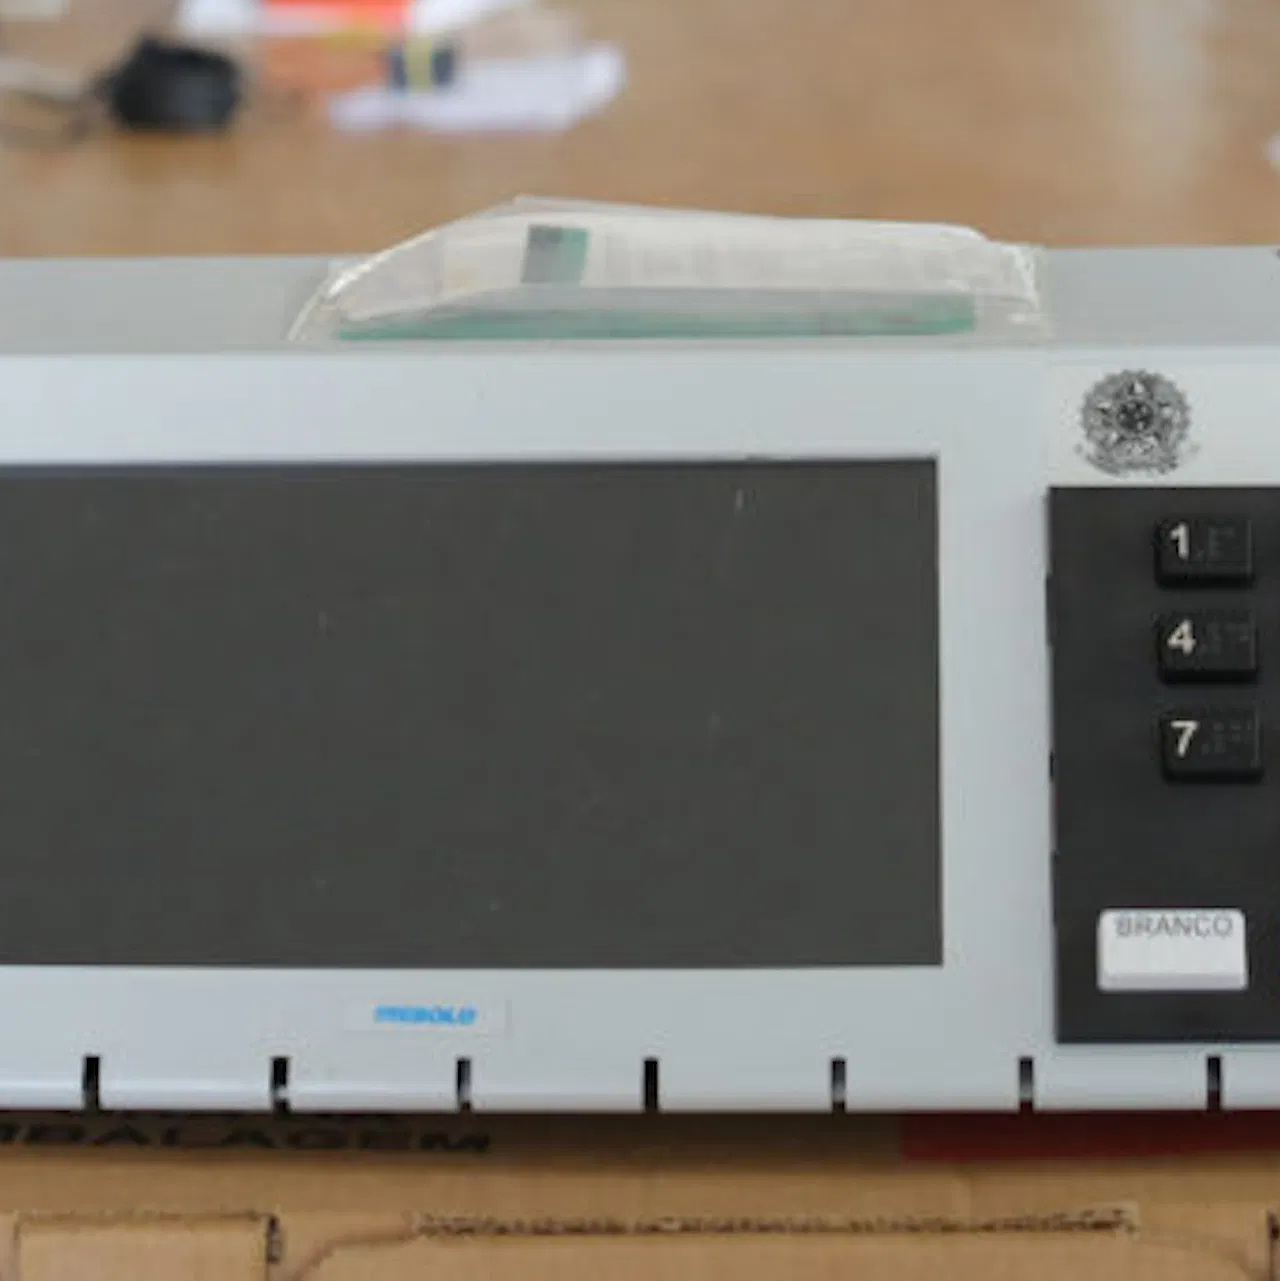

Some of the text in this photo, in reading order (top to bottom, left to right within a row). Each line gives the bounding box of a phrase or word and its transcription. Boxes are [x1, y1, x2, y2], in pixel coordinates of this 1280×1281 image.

[1170, 522, 1190, 560] 1
[1167, 620, 1197, 655] 4
[1170, 720, 1199, 757] 7
[1113, 912, 1234, 939] BRANCO
